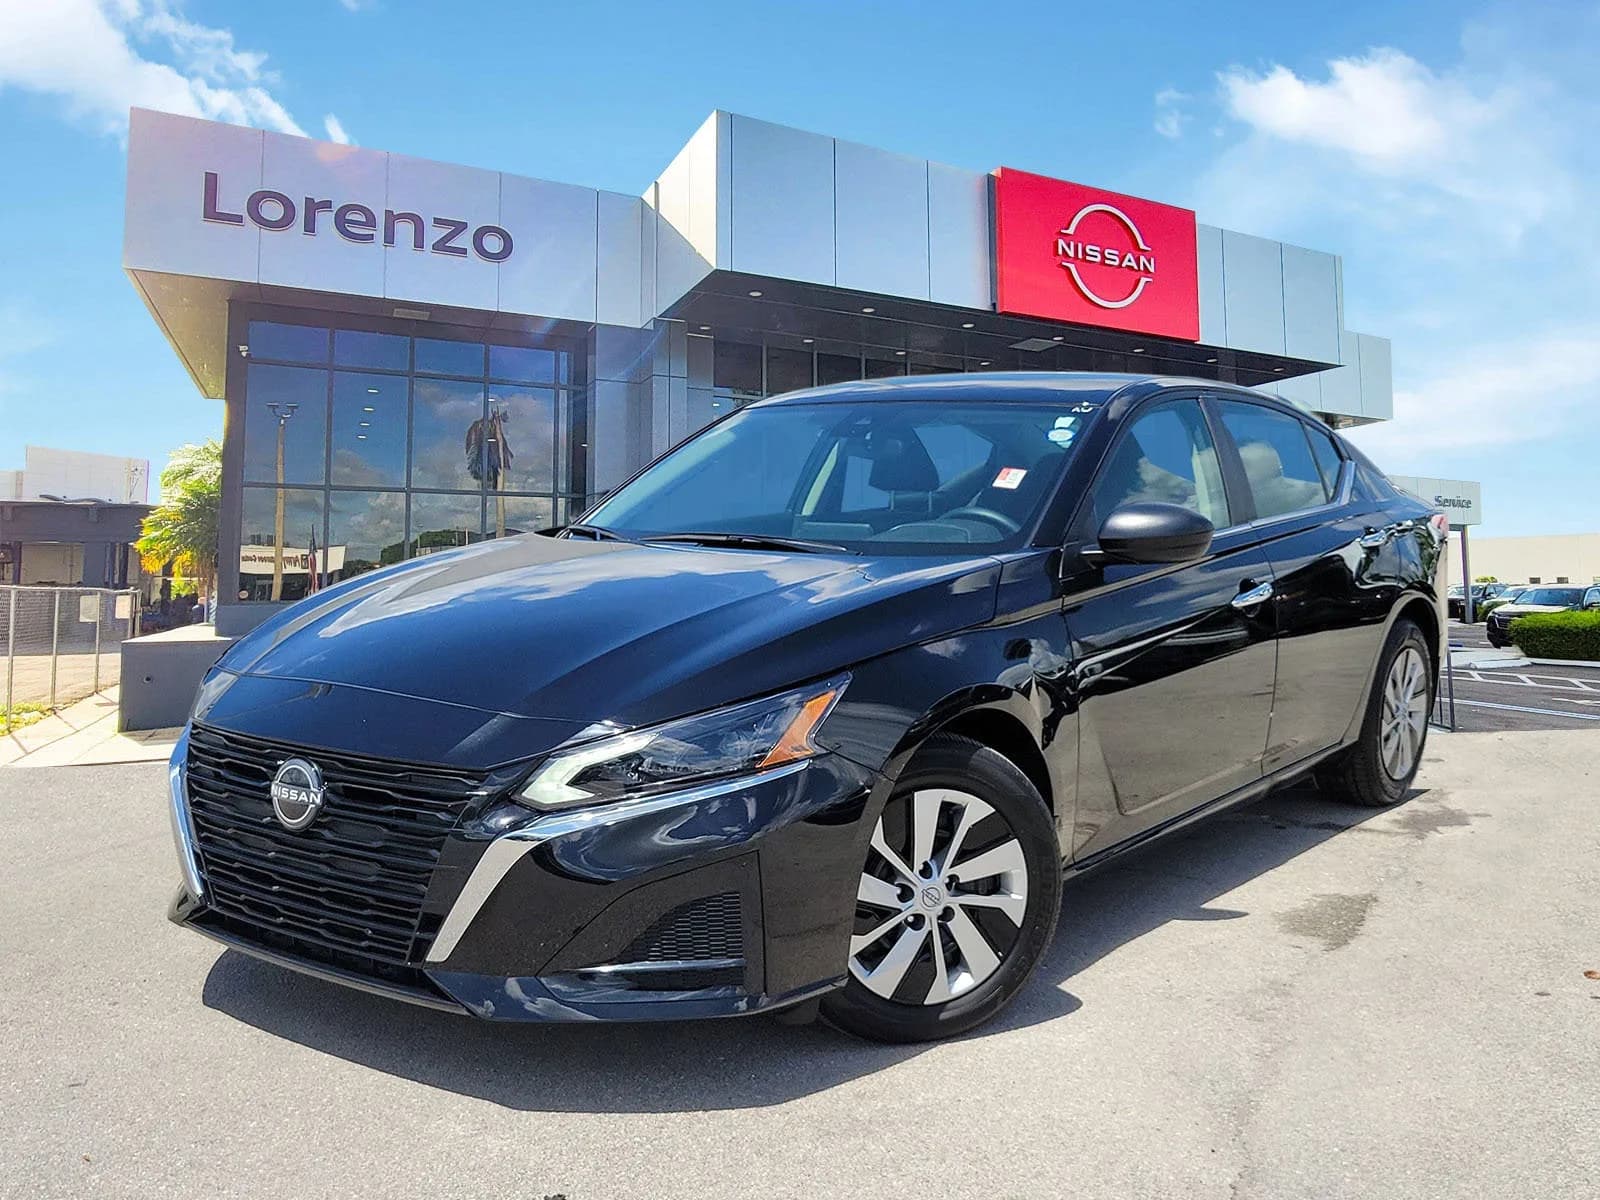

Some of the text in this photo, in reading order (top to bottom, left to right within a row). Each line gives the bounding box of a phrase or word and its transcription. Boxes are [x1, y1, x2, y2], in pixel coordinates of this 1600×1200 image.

[202, 171, 515, 263] Lorenzo
[1056, 238, 1155, 273] NISSAN
[1434, 495, 1472, 509] Service
[271, 783, 321, 804] NISSAN
